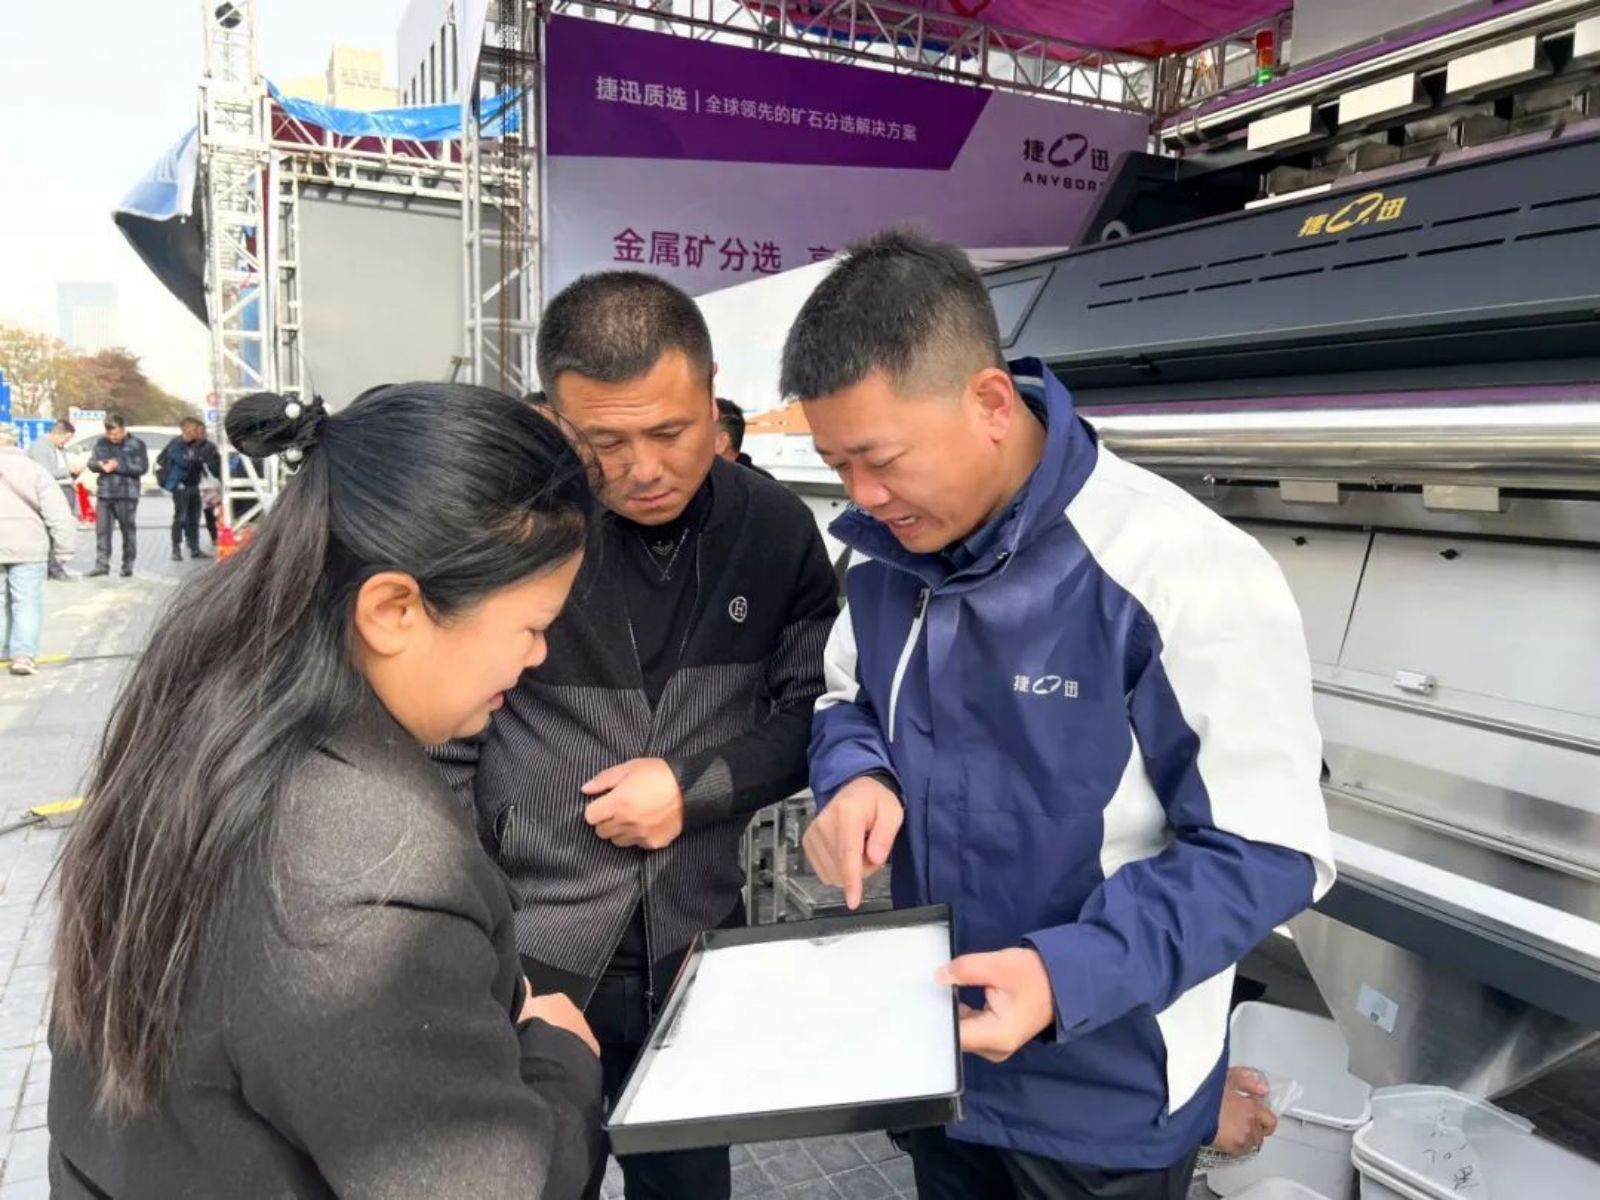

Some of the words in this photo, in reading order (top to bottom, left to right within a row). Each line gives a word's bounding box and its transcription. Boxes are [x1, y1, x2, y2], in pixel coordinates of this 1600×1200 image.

[596, 75, 688, 112] 捷迅质选
[705, 95, 917, 142] 全球领先的矿石分选解决方案
[613, 227, 782, 275] 金属矿分选
